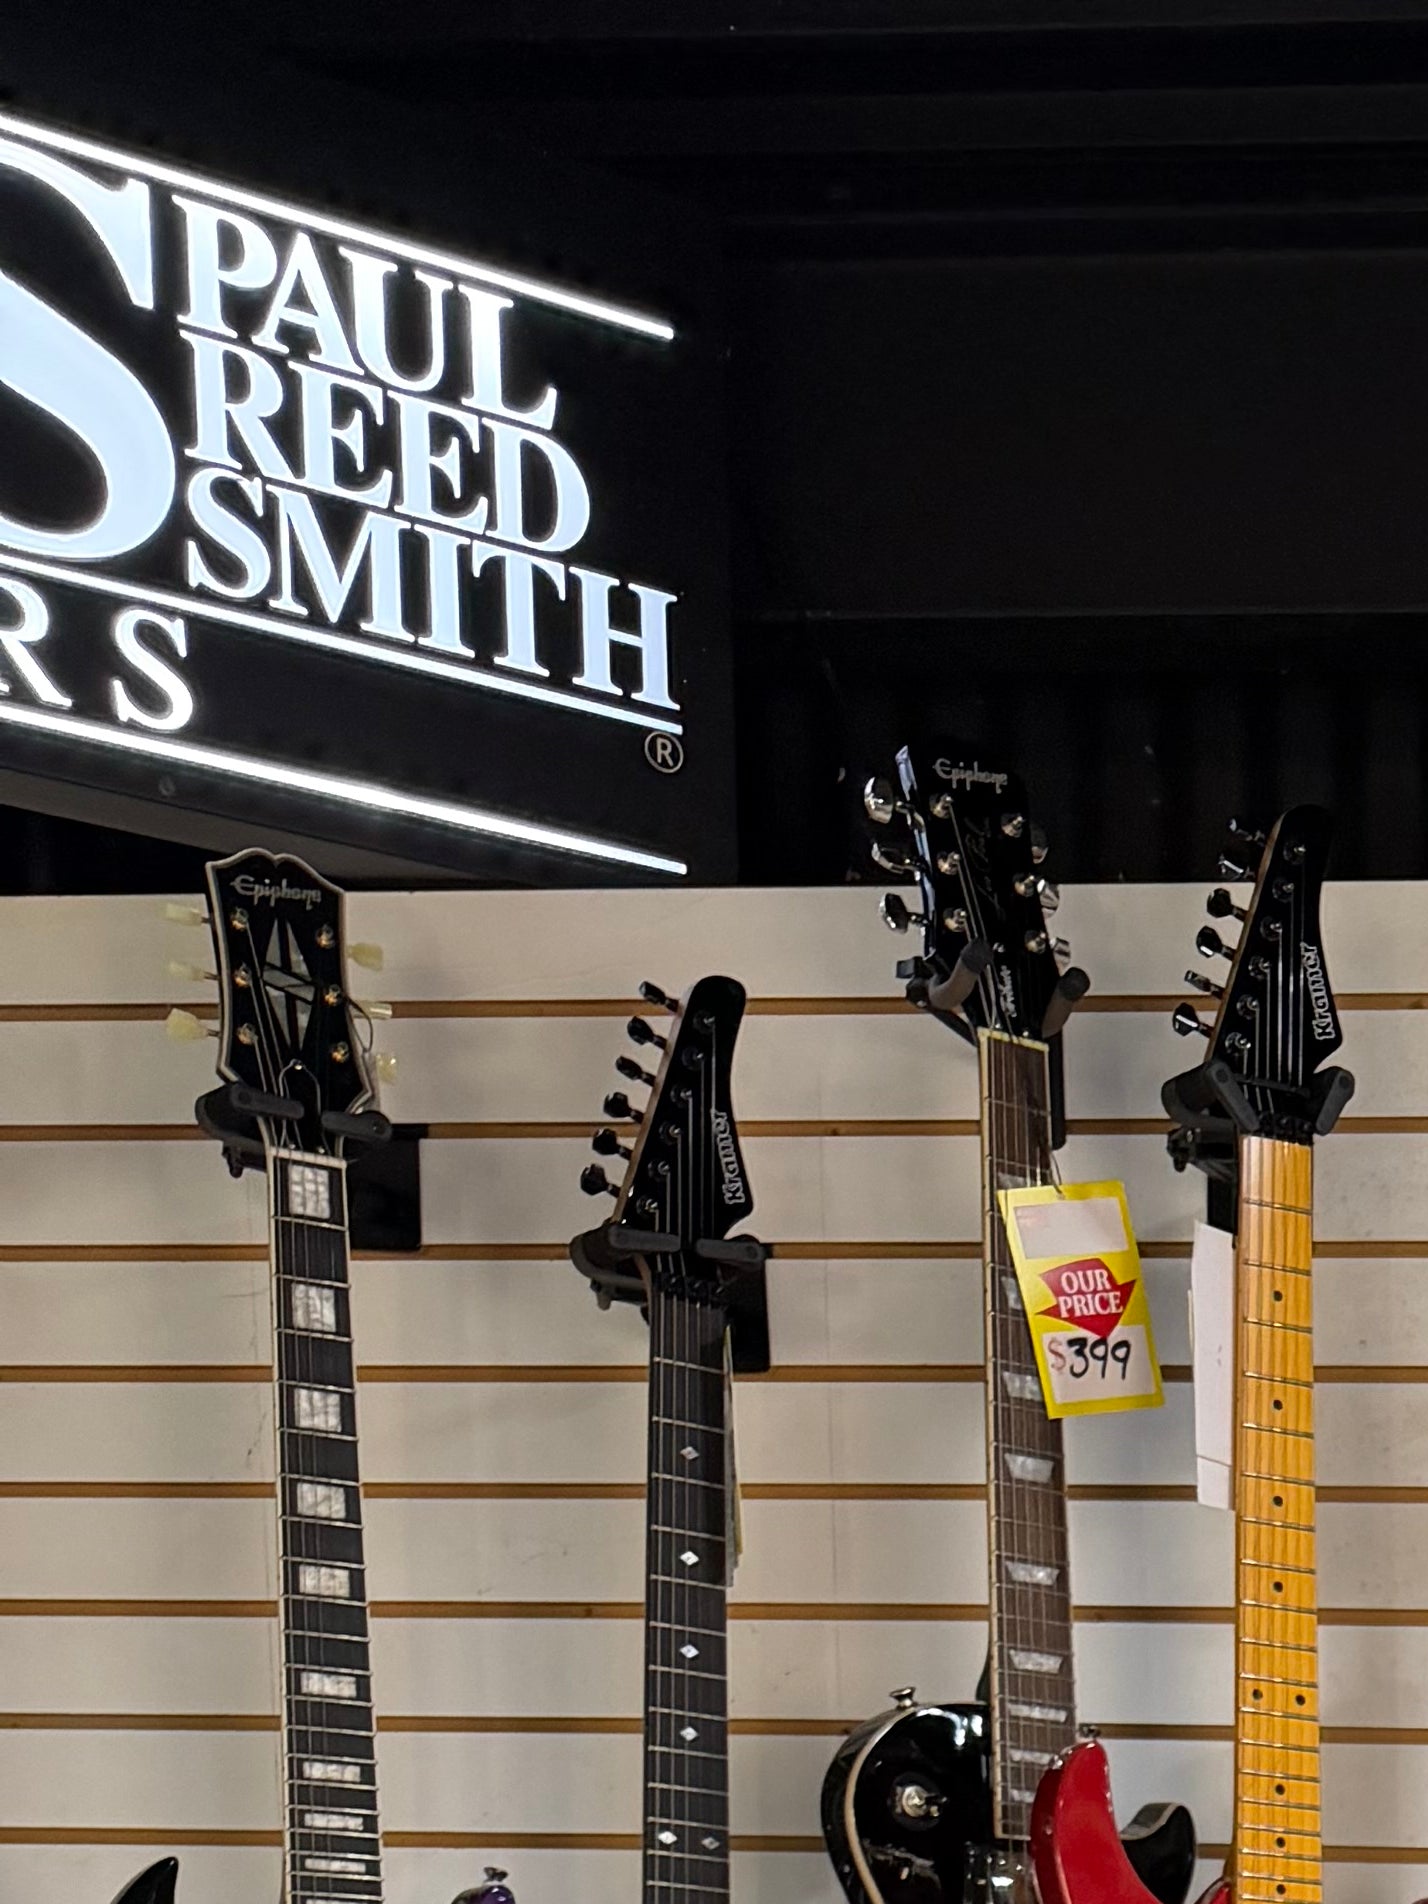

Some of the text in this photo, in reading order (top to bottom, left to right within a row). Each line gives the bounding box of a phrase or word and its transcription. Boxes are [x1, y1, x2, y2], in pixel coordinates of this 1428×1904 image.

[172, 195, 556, 430] PAUL
[178, 316, 590, 554] REED
[184, 467, 680, 712] SMITH
[932, 757, 1009, 795] Epiphone
[230, 874, 323, 911] Epiphone
[1300, 941, 1336, 1041] Kramer
[709, 1107, 745, 1205] Kramer
[1058, 1291, 1124, 1319] PRICE
[1061, 1268, 1112, 1295] OUR
[1048, 1337, 1132, 1381] $399
